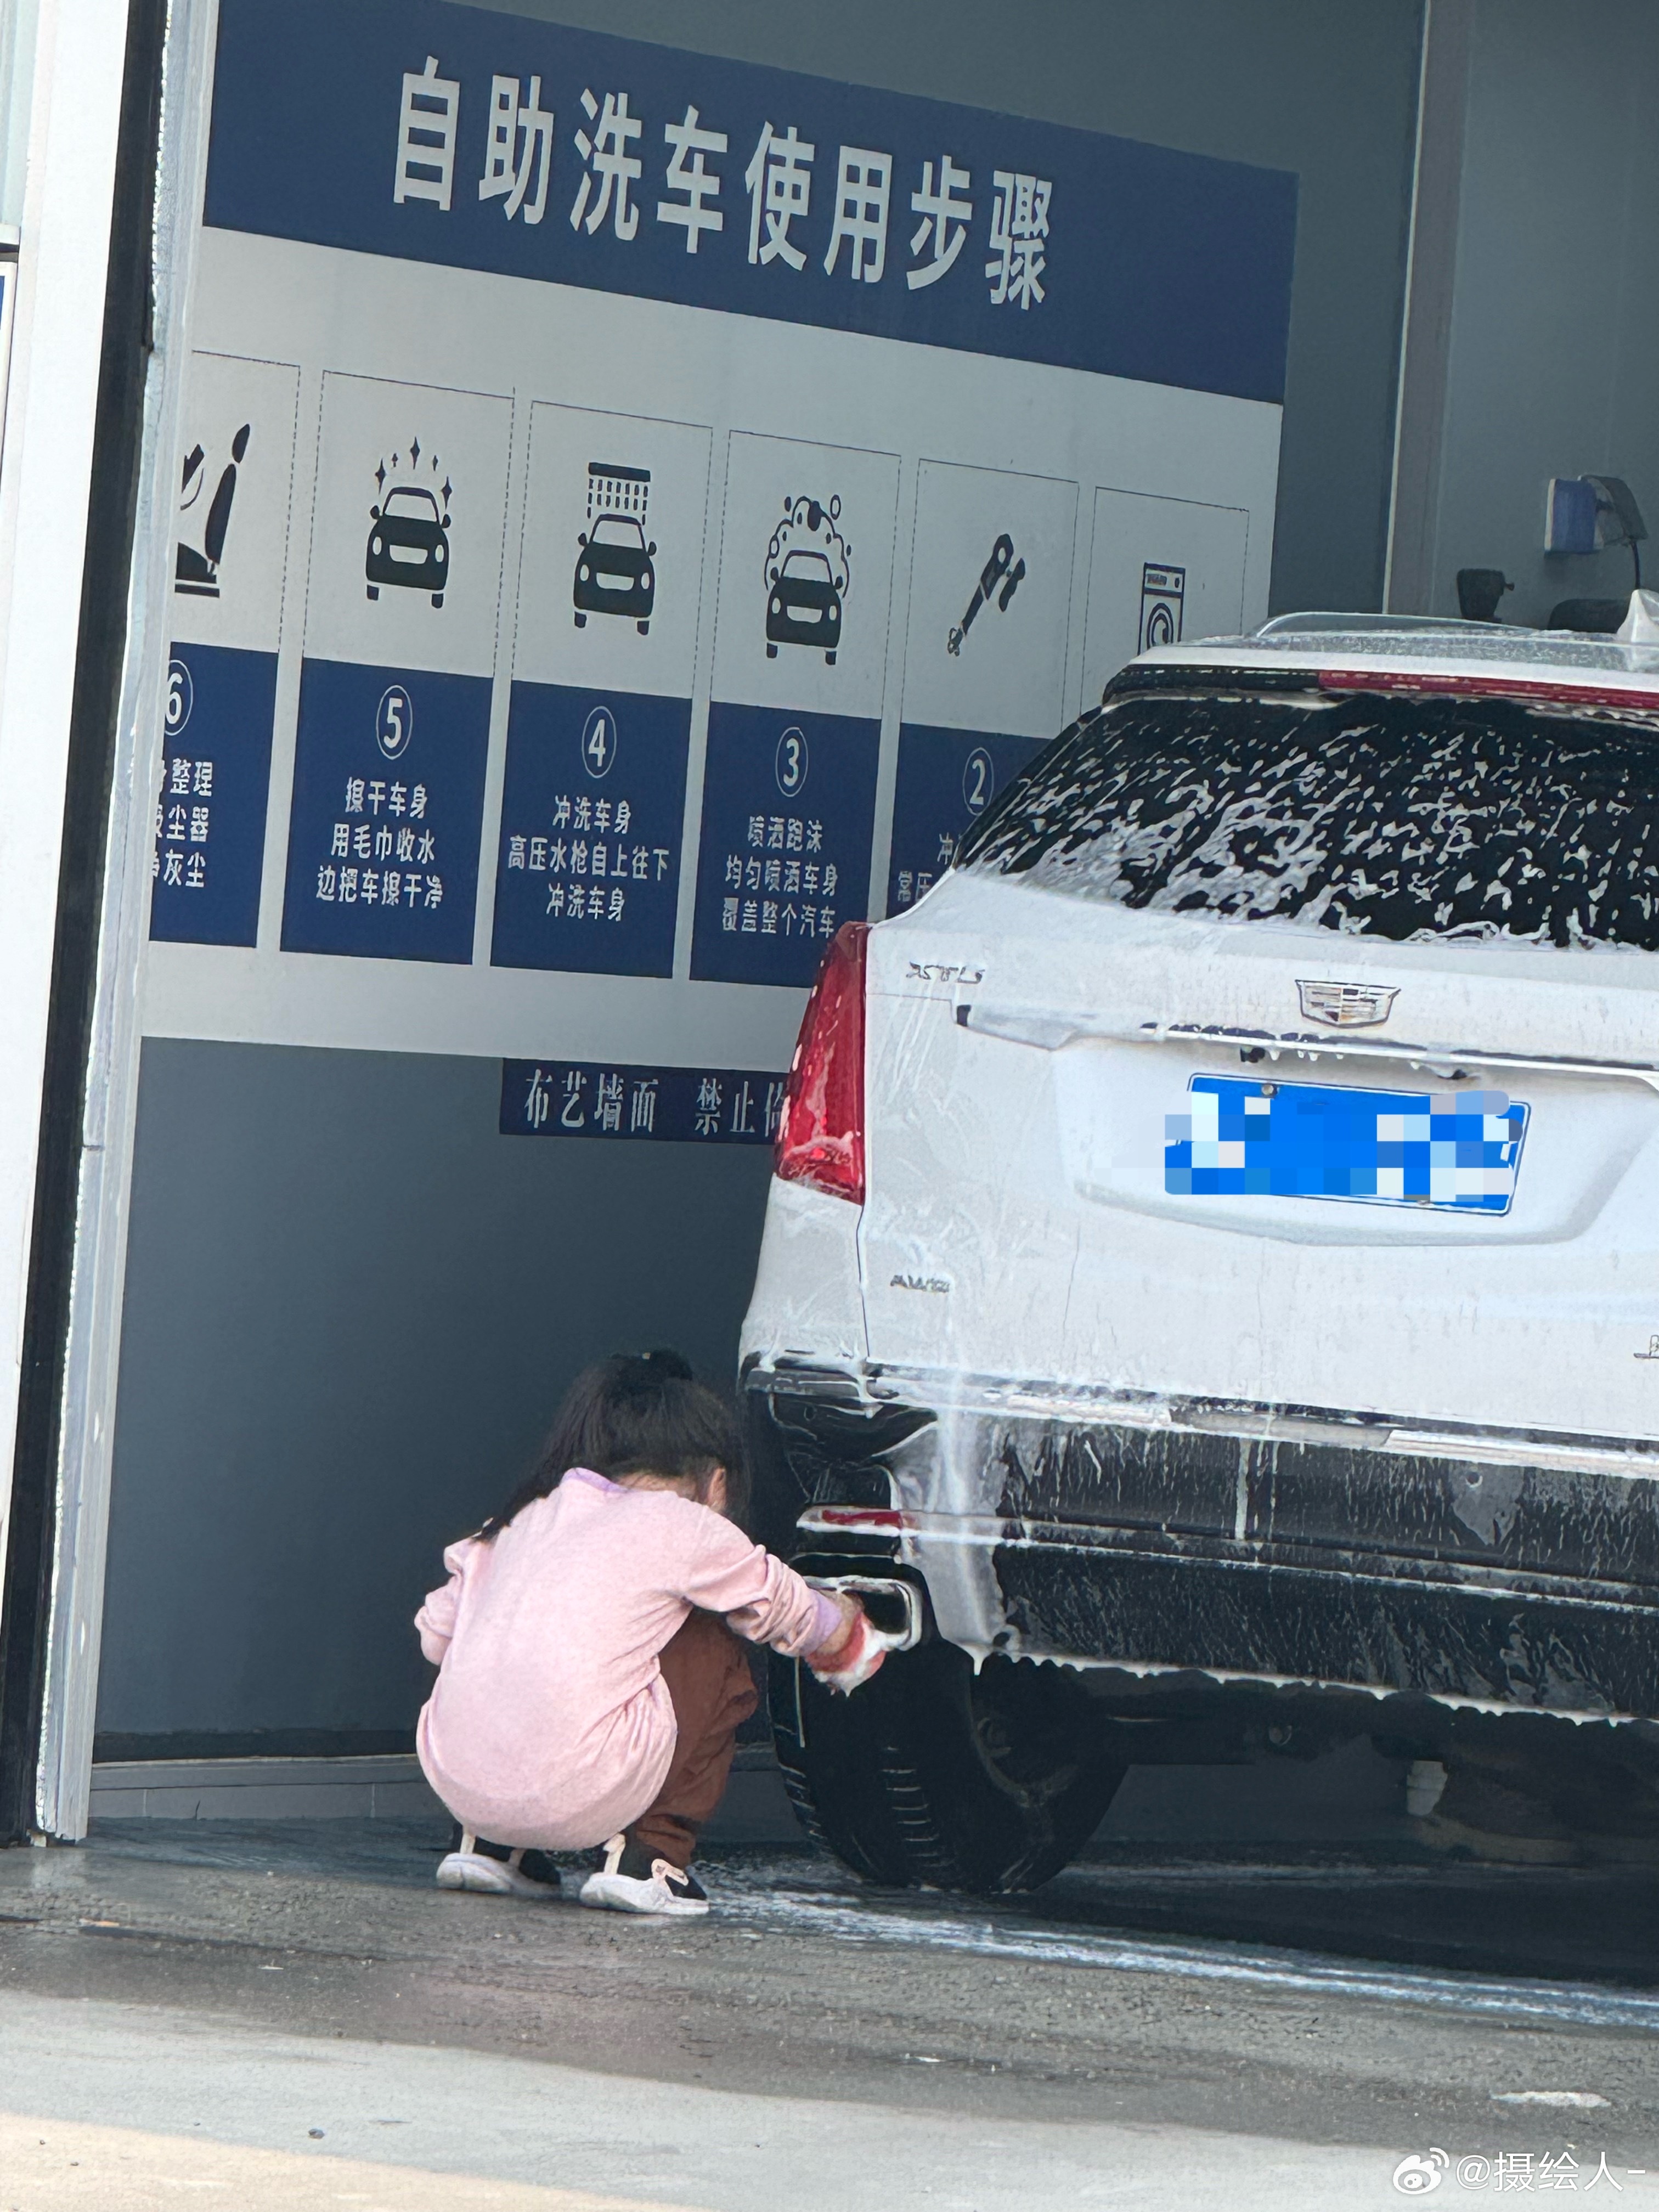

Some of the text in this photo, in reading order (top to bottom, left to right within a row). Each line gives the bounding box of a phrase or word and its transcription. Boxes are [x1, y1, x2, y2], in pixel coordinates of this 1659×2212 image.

[394, 56, 1052, 309] 自助洗车使用步骤
[346, 777, 427, 819] 擦干车身
[553, 795, 631, 833] 冲洗车身
[331, 823, 434, 864] 用毛巾收水
[748, 816, 822, 853] 喷洒泡沫
[509, 835, 669, 881] 高压水枪自上往下
[726, 855, 837, 896] 均匀喷洒车身
[547, 883, 624, 921] 冲洗车身
[723, 898, 835, 938] 覆盖整个汽车
[525, 1069, 658, 1132] 布艺墙面
